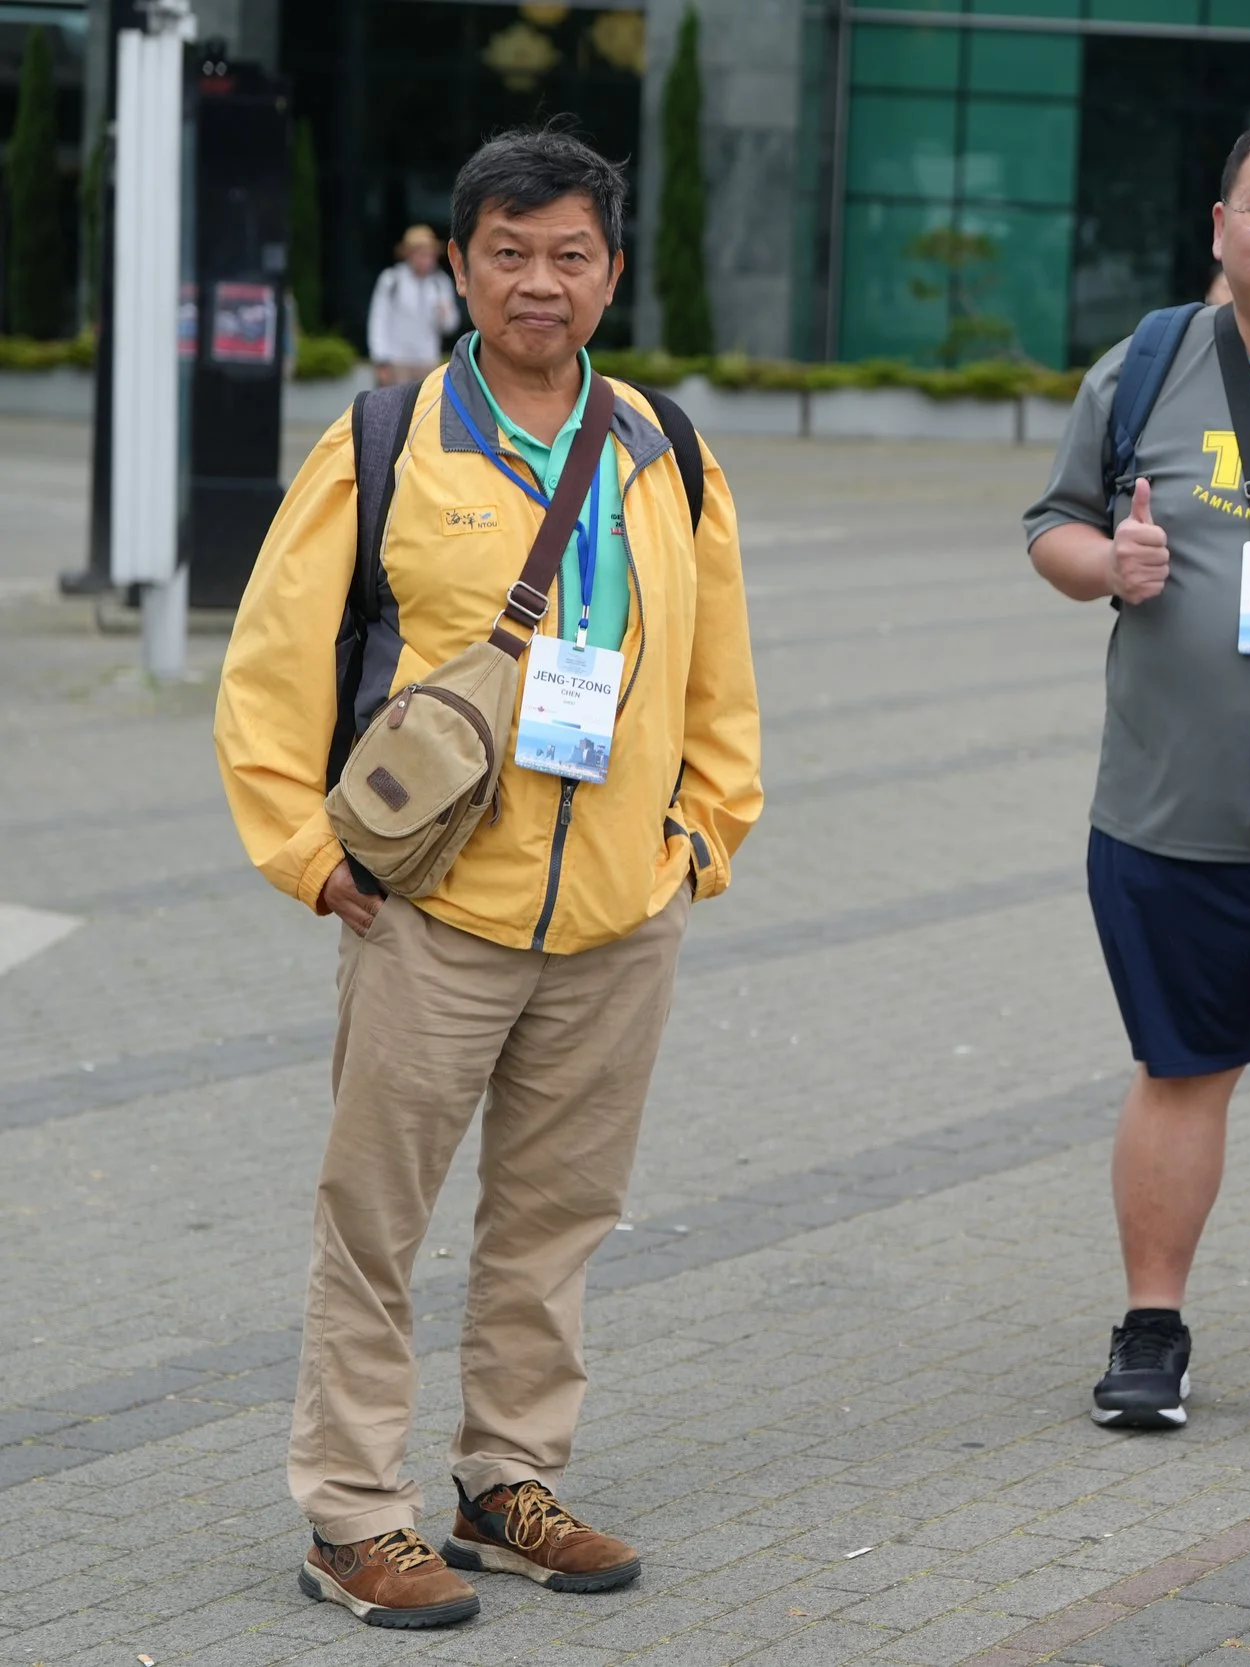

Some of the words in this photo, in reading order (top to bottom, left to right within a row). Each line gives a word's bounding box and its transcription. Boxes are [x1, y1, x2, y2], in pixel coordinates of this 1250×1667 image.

[477, 520, 497, 529] NTOU
[533, 670, 612, 695] JENG-TZONG
[561, 688, 581, 699] CHEN
